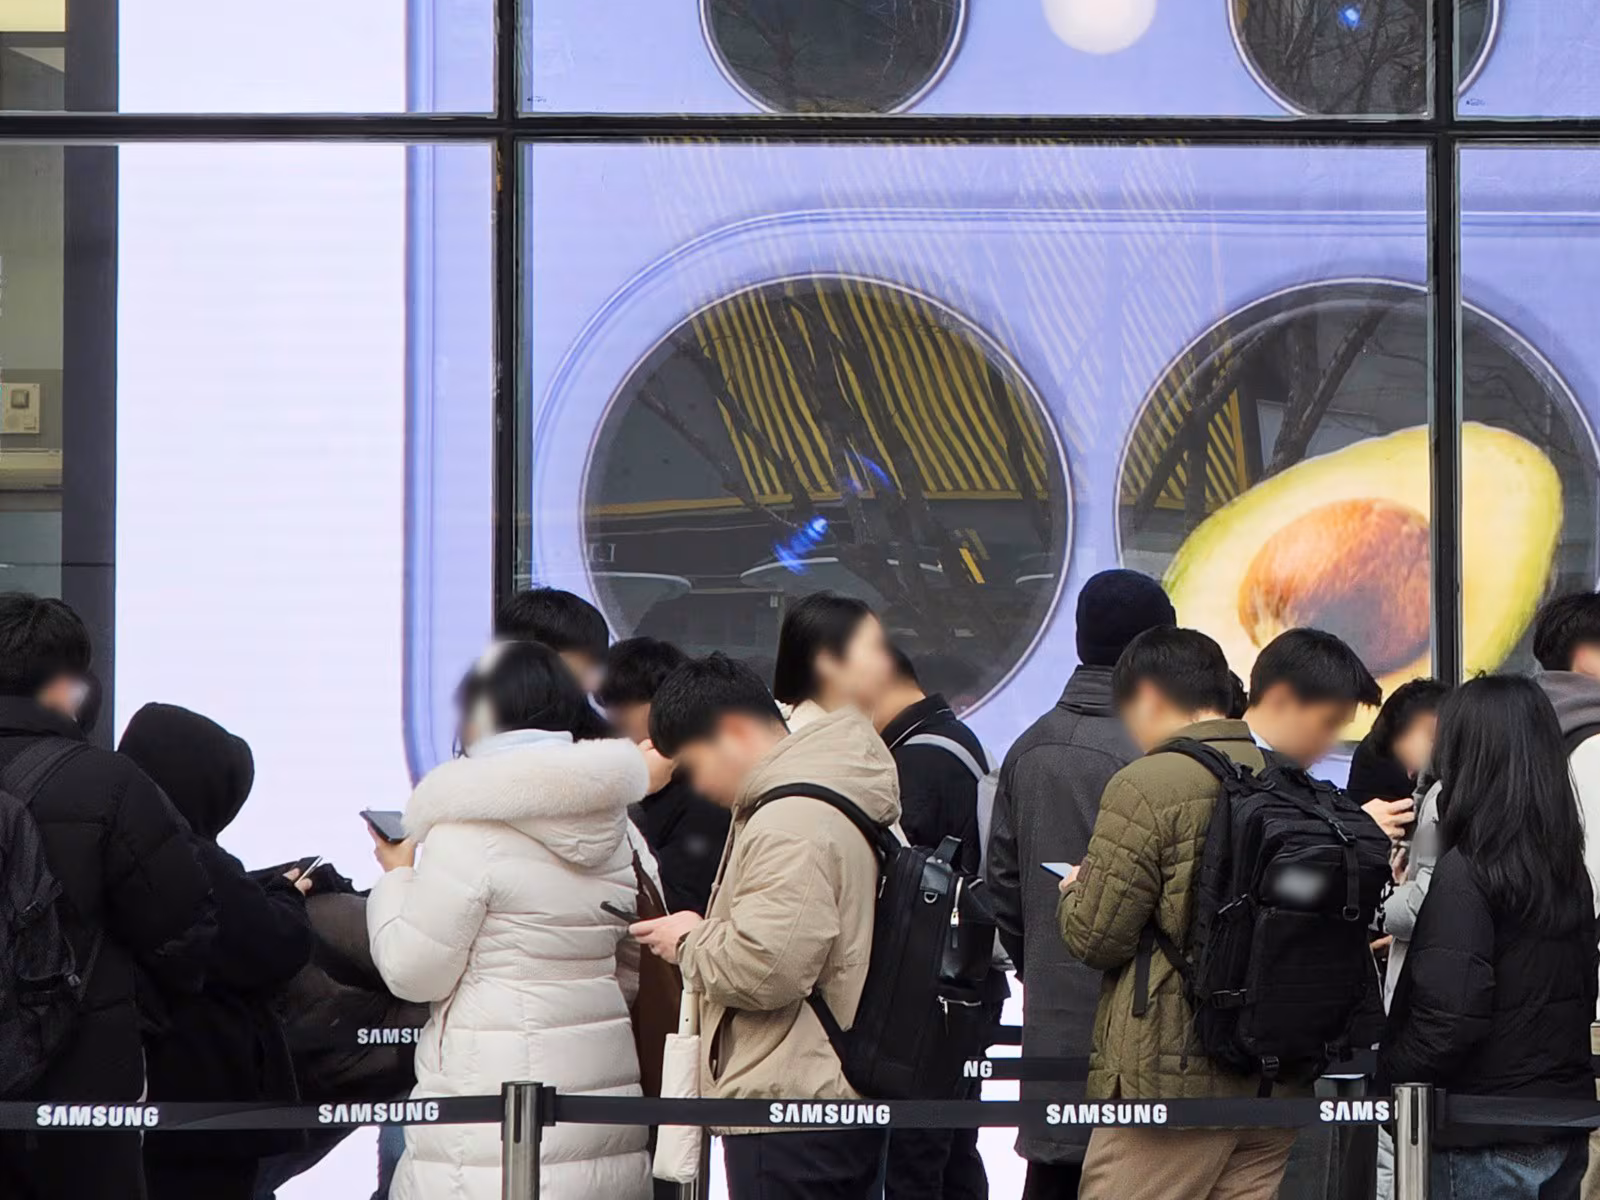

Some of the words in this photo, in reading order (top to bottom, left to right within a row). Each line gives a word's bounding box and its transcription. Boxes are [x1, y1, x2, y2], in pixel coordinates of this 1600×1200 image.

[357, 1027, 422, 1045] SAMSU
[36, 1104, 159, 1128] SAMSUNG
[318, 1101, 440, 1123] SAMSUNG
[769, 1102, 891, 1125] SAMSUNG
[1046, 1103, 1168, 1125] SAMSUNG
[1319, 1100, 1390, 1122] SAMS
